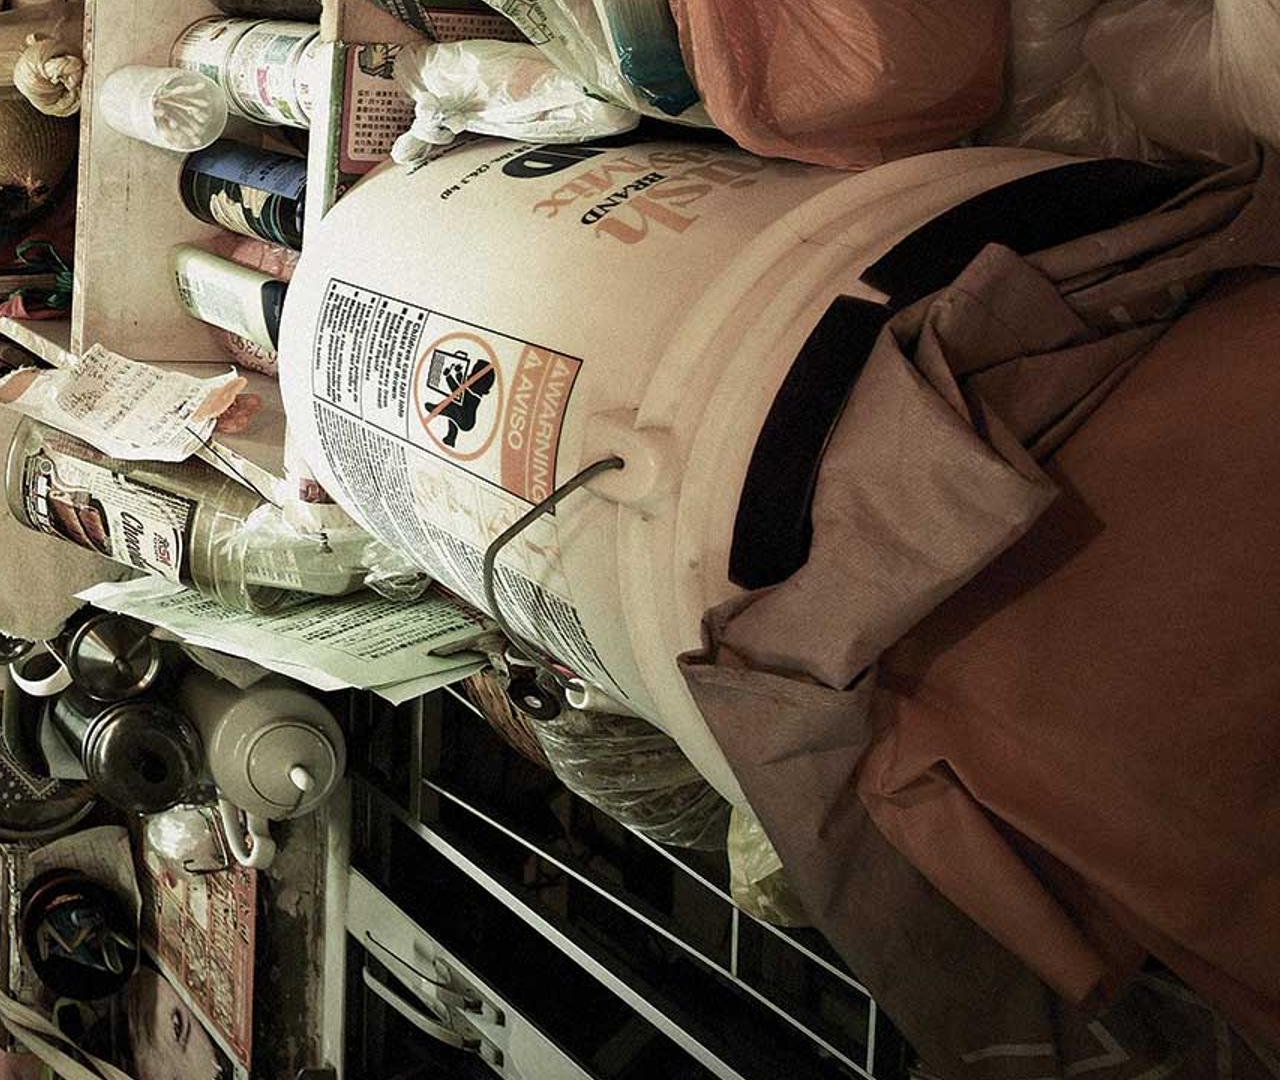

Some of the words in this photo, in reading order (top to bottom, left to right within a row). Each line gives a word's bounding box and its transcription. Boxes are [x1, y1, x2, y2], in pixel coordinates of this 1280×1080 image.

[532, 155, 650, 219] Mix
[579, 171, 669, 225] BRAND
[398, 319, 413, 350] bucket
[404, 322, 422, 361] Children
[395, 351, 405, 369] and
[400, 362, 410, 380] can
[399, 381, 408, 399] fall
[397, 399, 406, 418] into
[507, 373, 535, 451] AVISO
[530, 380, 566, 505] WARNING
